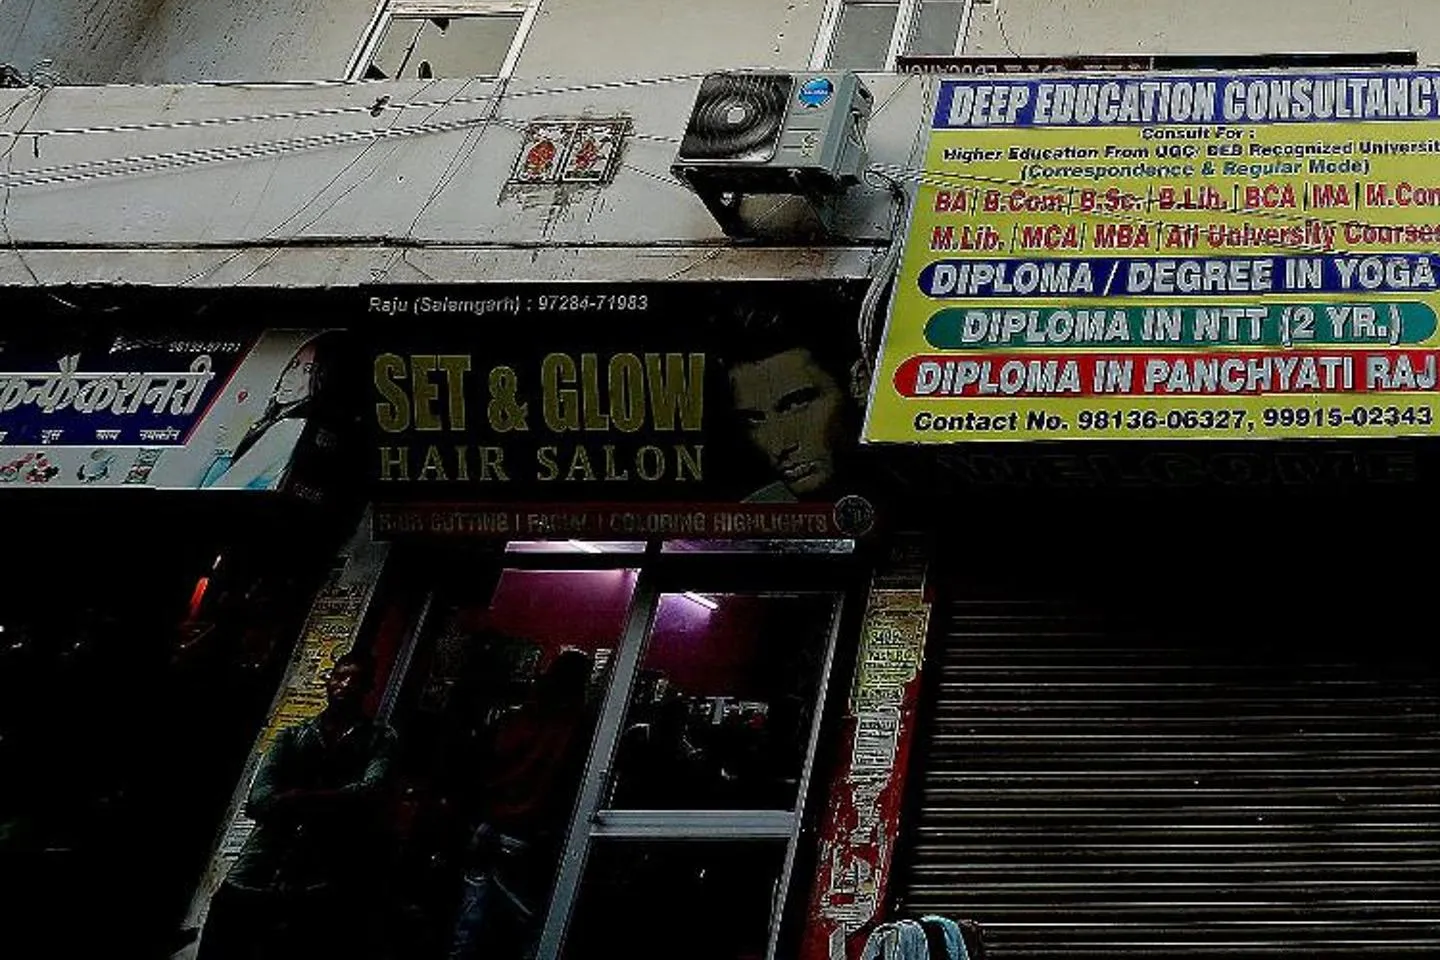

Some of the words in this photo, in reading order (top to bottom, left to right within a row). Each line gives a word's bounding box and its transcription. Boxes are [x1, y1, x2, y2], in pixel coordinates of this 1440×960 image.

[949, 85, 1031, 126] DEEP
[1034, 81, 1219, 123] EDUCATION
[1141, 127, 1210, 140] Consult
[1216, 127, 1245, 139] For
[943, 147, 1003, 163] Higher
[1008, 145, 1099, 160] Education
[1104, 145, 1150, 159] From
[1249, 142, 1353, 158] Recognized
[1021, 162, 1195, 182] (Correspondence
[1201, 162, 1216, 176] &
[1223, 160, 1302, 179] Regular
[1308, 158, 1371, 175] Mode)
[935, 190, 967, 213] BA
[1245, 185, 1296, 209] BCA
[1311, 184, 1350, 208] MA
[1021, 224, 1078, 249] MCA
[1093, 224, 1151, 249] MBA
[1165, 224, 1199, 249] All
[1206, 220, 1336, 252] University
[931, 264, 1095, 295] DIPLOMA
[1128, 262, 1273, 293] DEGREE
[1285, 262, 1323, 289] IN
[1332, 256, 1439, 288] YOGA
[368, 296, 409, 316] Raju
[537, 294, 649, 312] 97284-71983
[960, 306, 1125, 344] DIPLOMA
[1141, 306, 1184, 341] IN
[1193, 304, 1270, 340] NTT
[1280, 305, 1316, 347] (2
[1325, 304, 1402, 344] YR.)
[914, 360, 1082, 394] DIPLOMA
[1093, 360, 1134, 393] IN
[1143, 356, 1354, 393] PANCHYATI
[1365, 355, 1438, 390] RAJ
[372, 352, 472, 434] SET
[486, 364, 531, 434] &
[540, 351, 707, 433] GLOW
[914, 411, 1017, 431] Contact
[1025, 411, 1069, 431] No.
[1077, 410, 1255, 433] 98136-06327,
[1262, 408, 1434, 429] 99915-02343
[377, 445, 512, 483] HAIR
[534, 444, 705, 483] SALON
